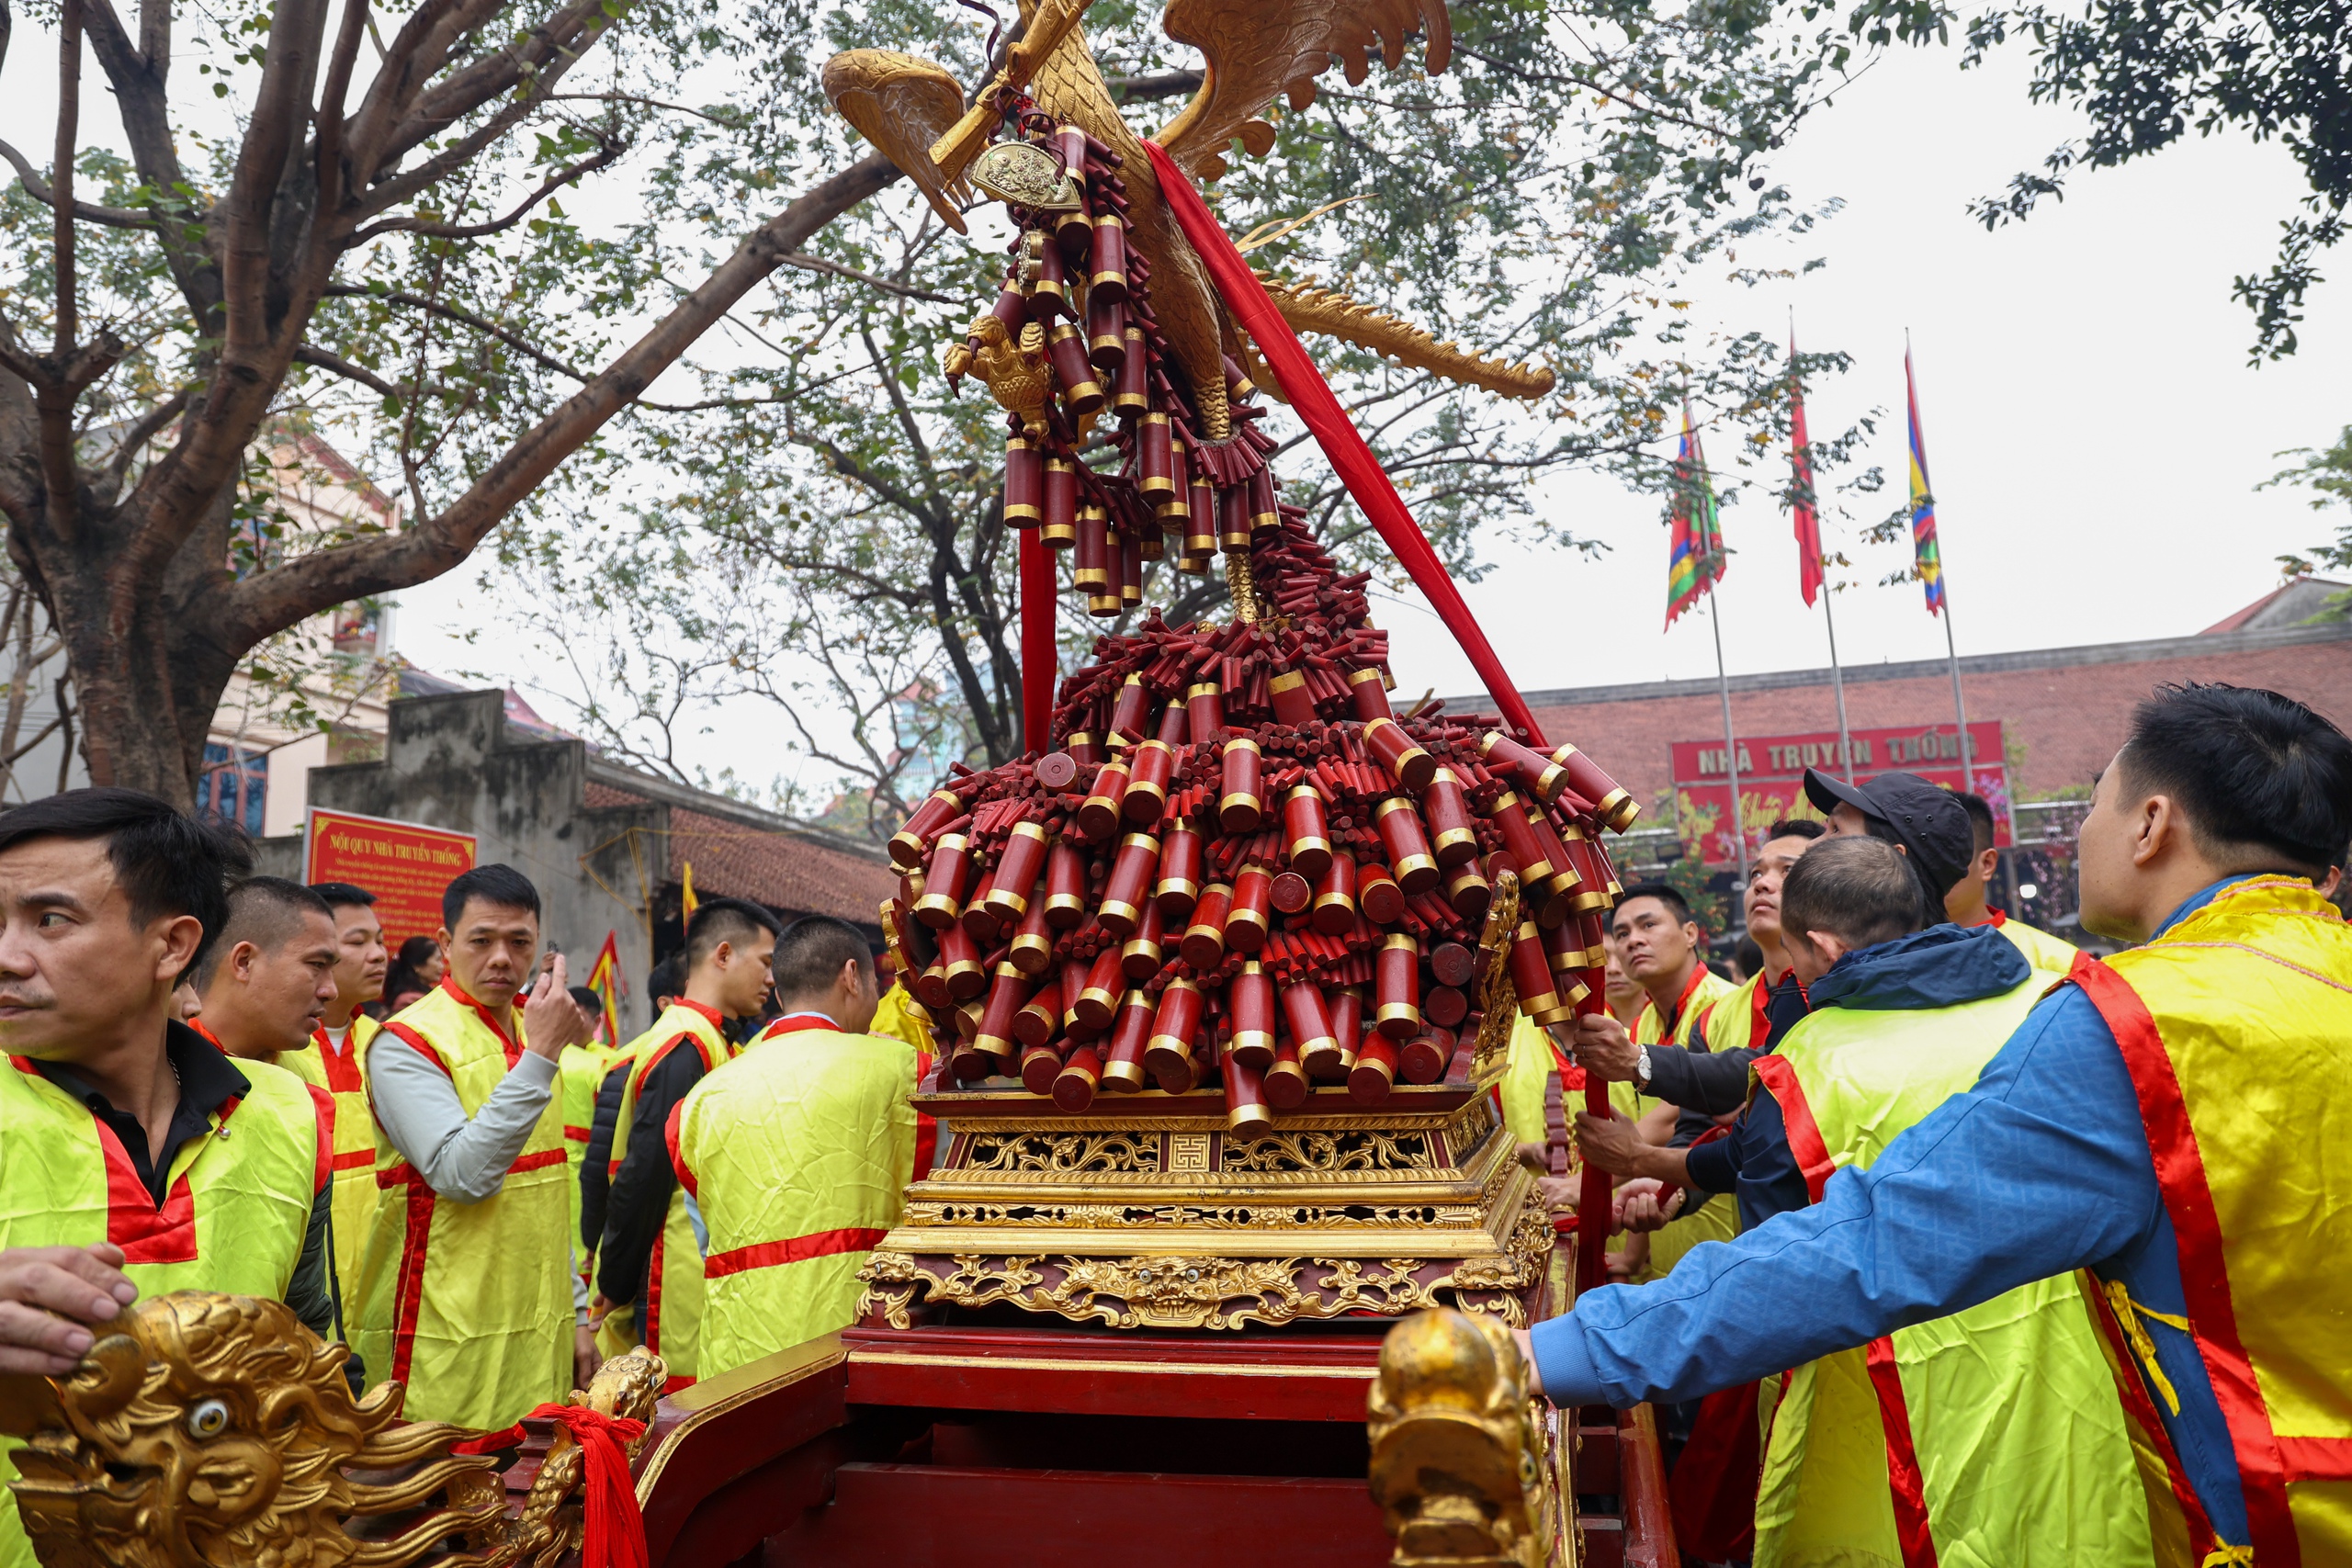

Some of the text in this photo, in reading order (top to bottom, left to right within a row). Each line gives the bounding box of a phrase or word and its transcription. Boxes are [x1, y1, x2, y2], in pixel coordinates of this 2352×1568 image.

[1698, 741, 1754, 774] NHÀ
[330, 831, 461, 867] NỘI QUY NHÀ TRUYỀN THỐNG
